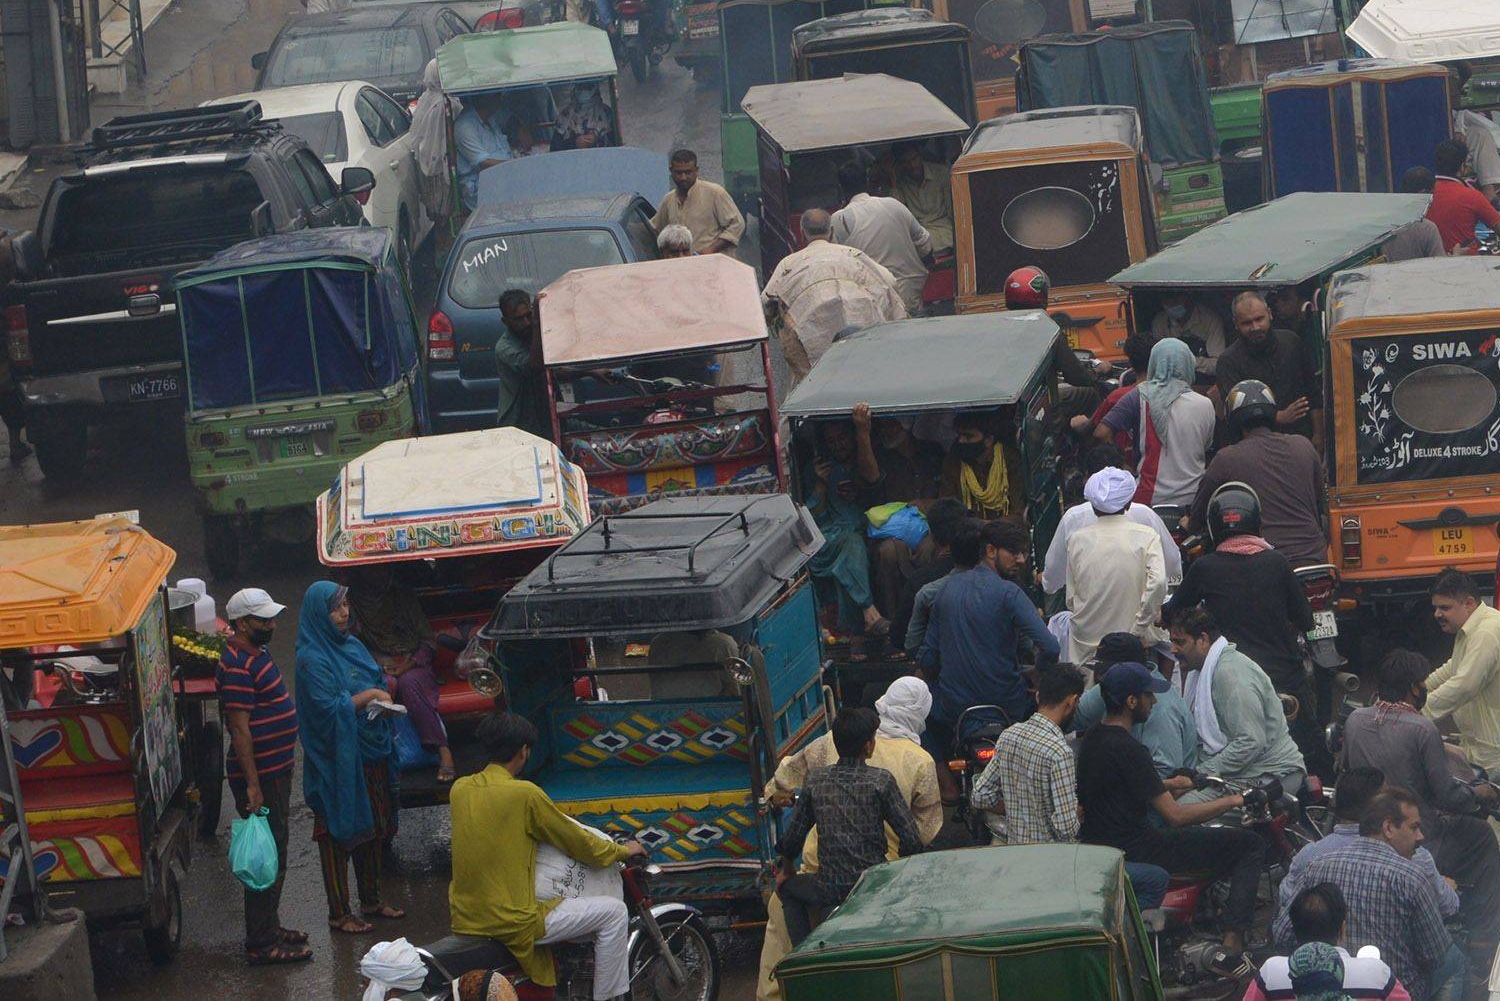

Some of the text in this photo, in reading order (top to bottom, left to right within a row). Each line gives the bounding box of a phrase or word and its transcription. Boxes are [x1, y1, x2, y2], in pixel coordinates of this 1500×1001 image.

[462, 239, 508, 273] MIAN
[1413, 342, 1471, 361] SIWA
[130, 379, 177, 395] KN-7766
[1413, 445, 1482, 458] DELUXE 4 STROKE
[354, 514, 554, 552] QINGQI
[1367, 528, 1389, 536] SIWA
[1441, 530, 1463, 540] LEU
[1439, 543, 1466, 554] 4759
